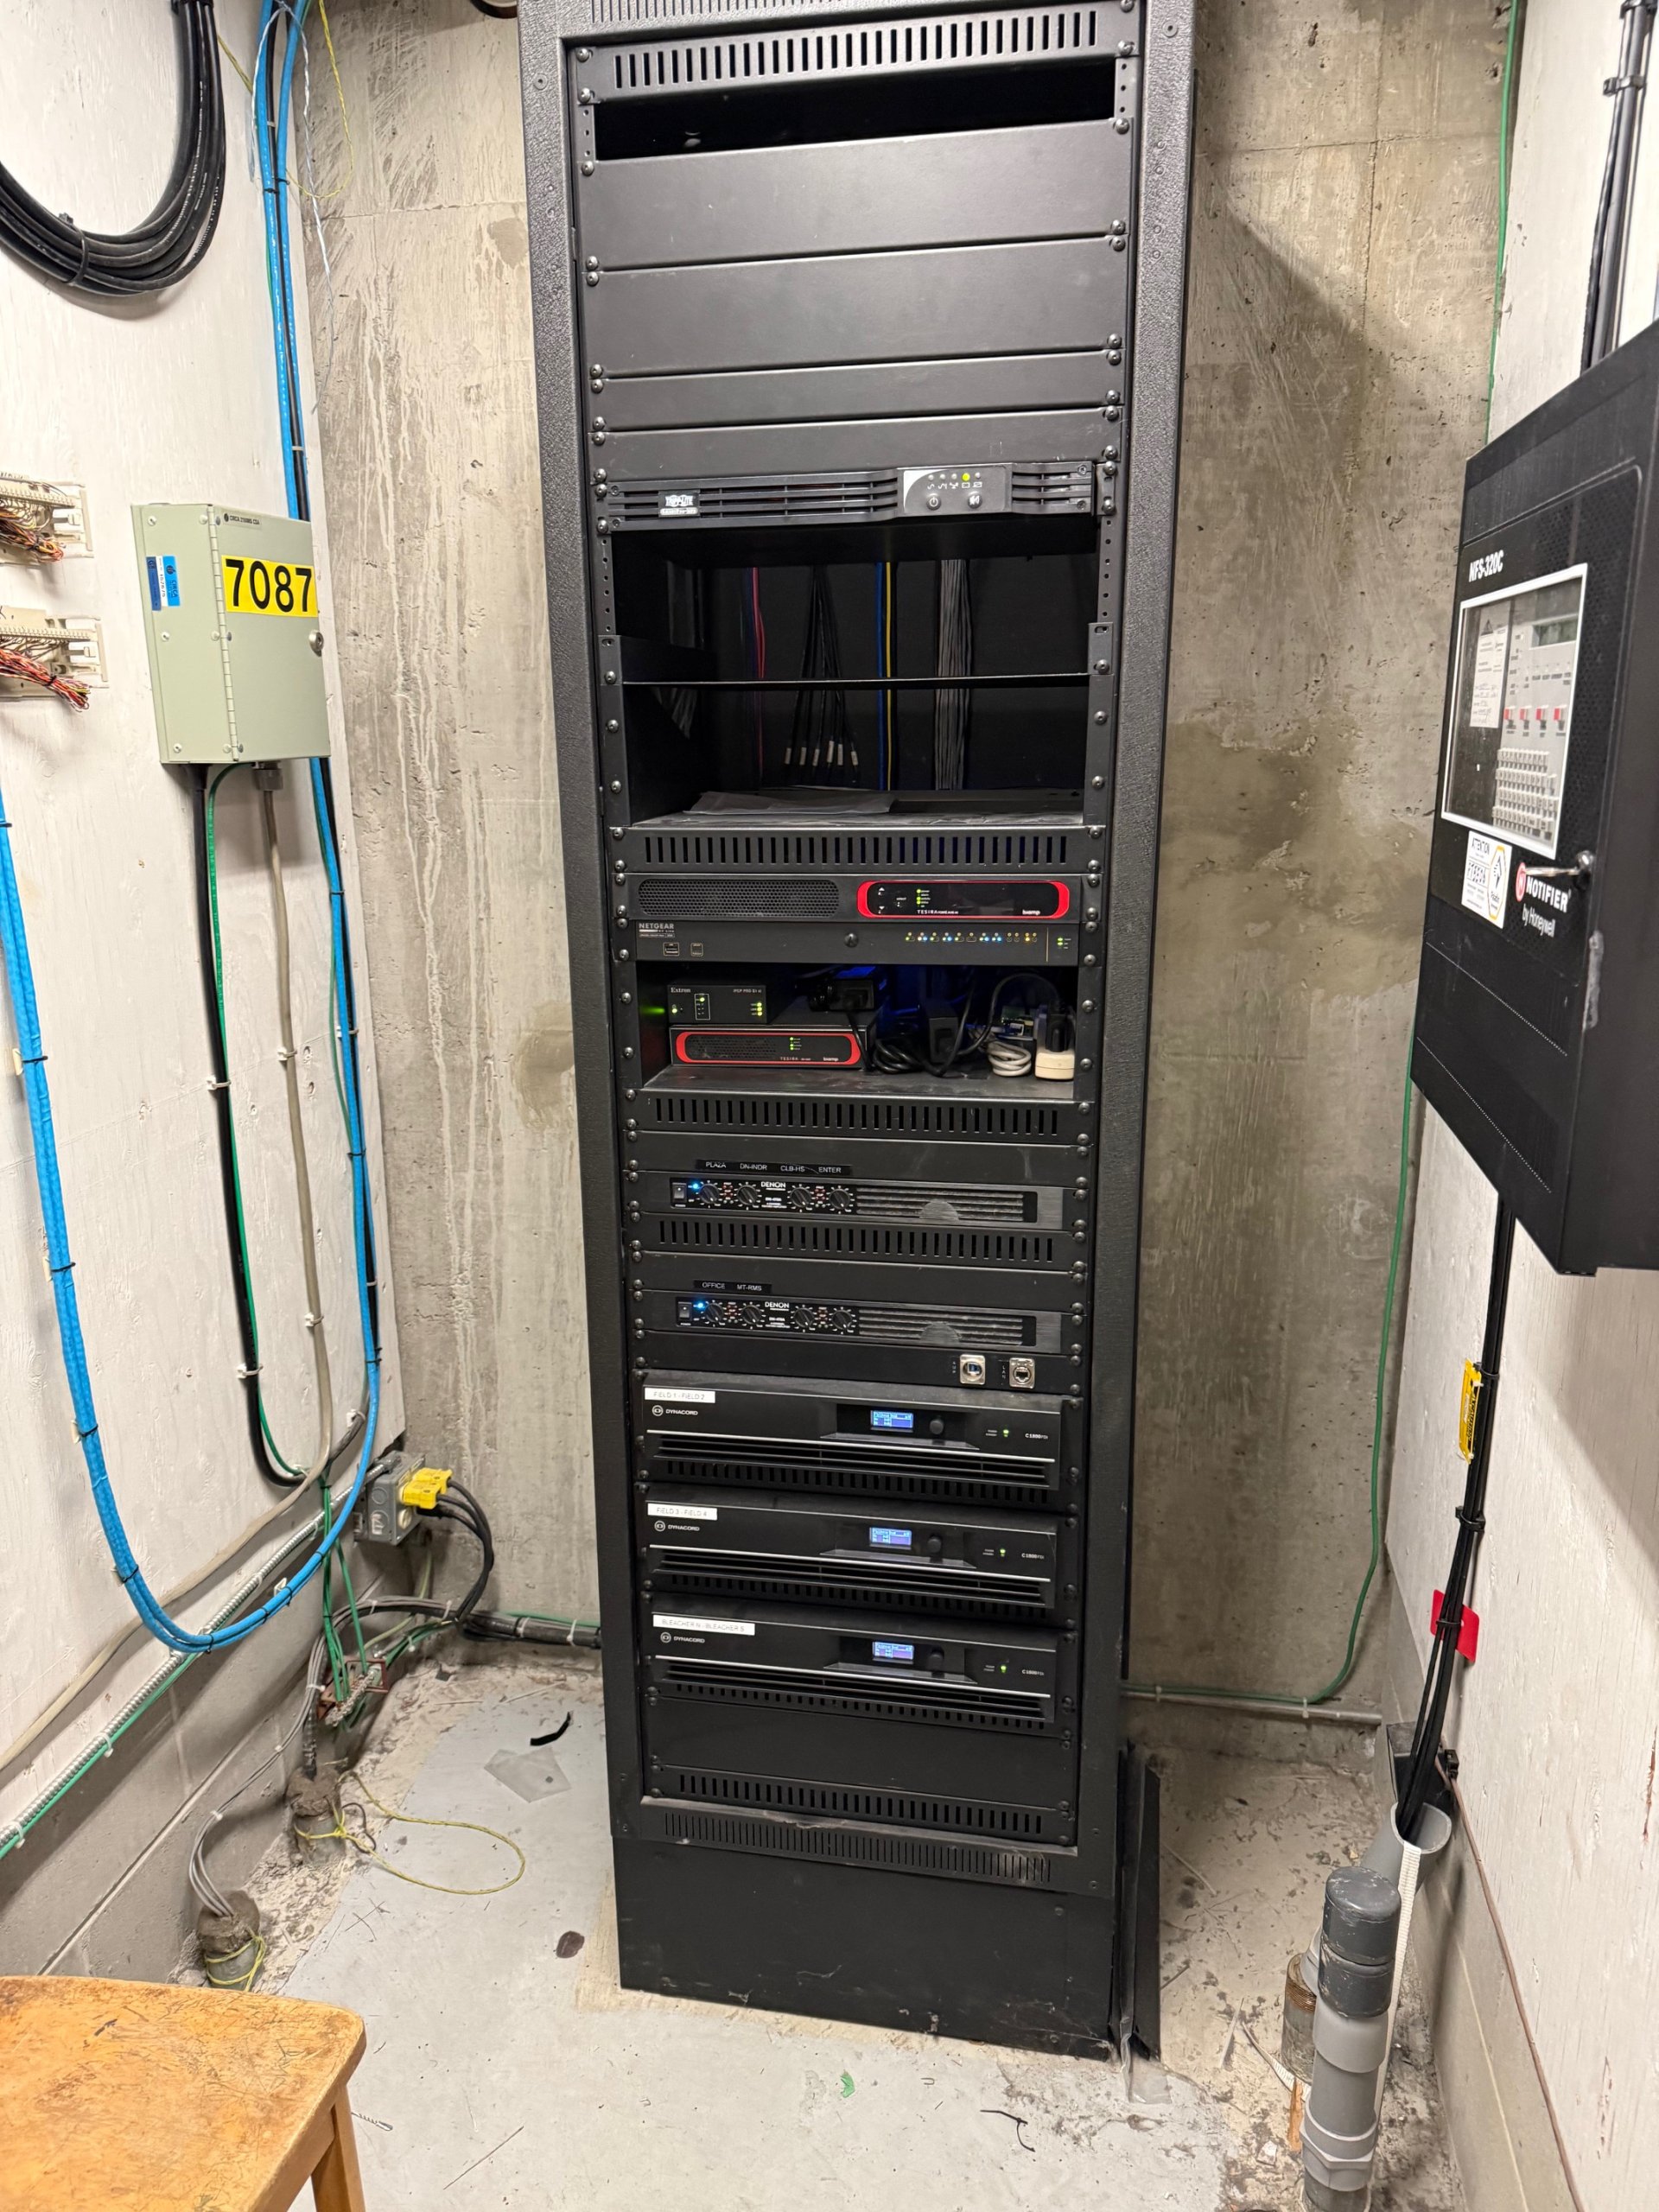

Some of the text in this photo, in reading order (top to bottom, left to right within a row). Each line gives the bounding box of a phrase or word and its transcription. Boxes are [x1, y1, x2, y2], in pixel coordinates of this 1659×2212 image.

[1469, 550, 1504, 582] NFS-320C
[226, 558, 312, 613] 7087
[1526, 875, 1569, 913] NOTIFIER
[1522, 903, 1556, 938] by Honeywell
[662, 1618, 694, 1627] BLEACHER
[705, 1623, 739, 1632] BLEACHER
